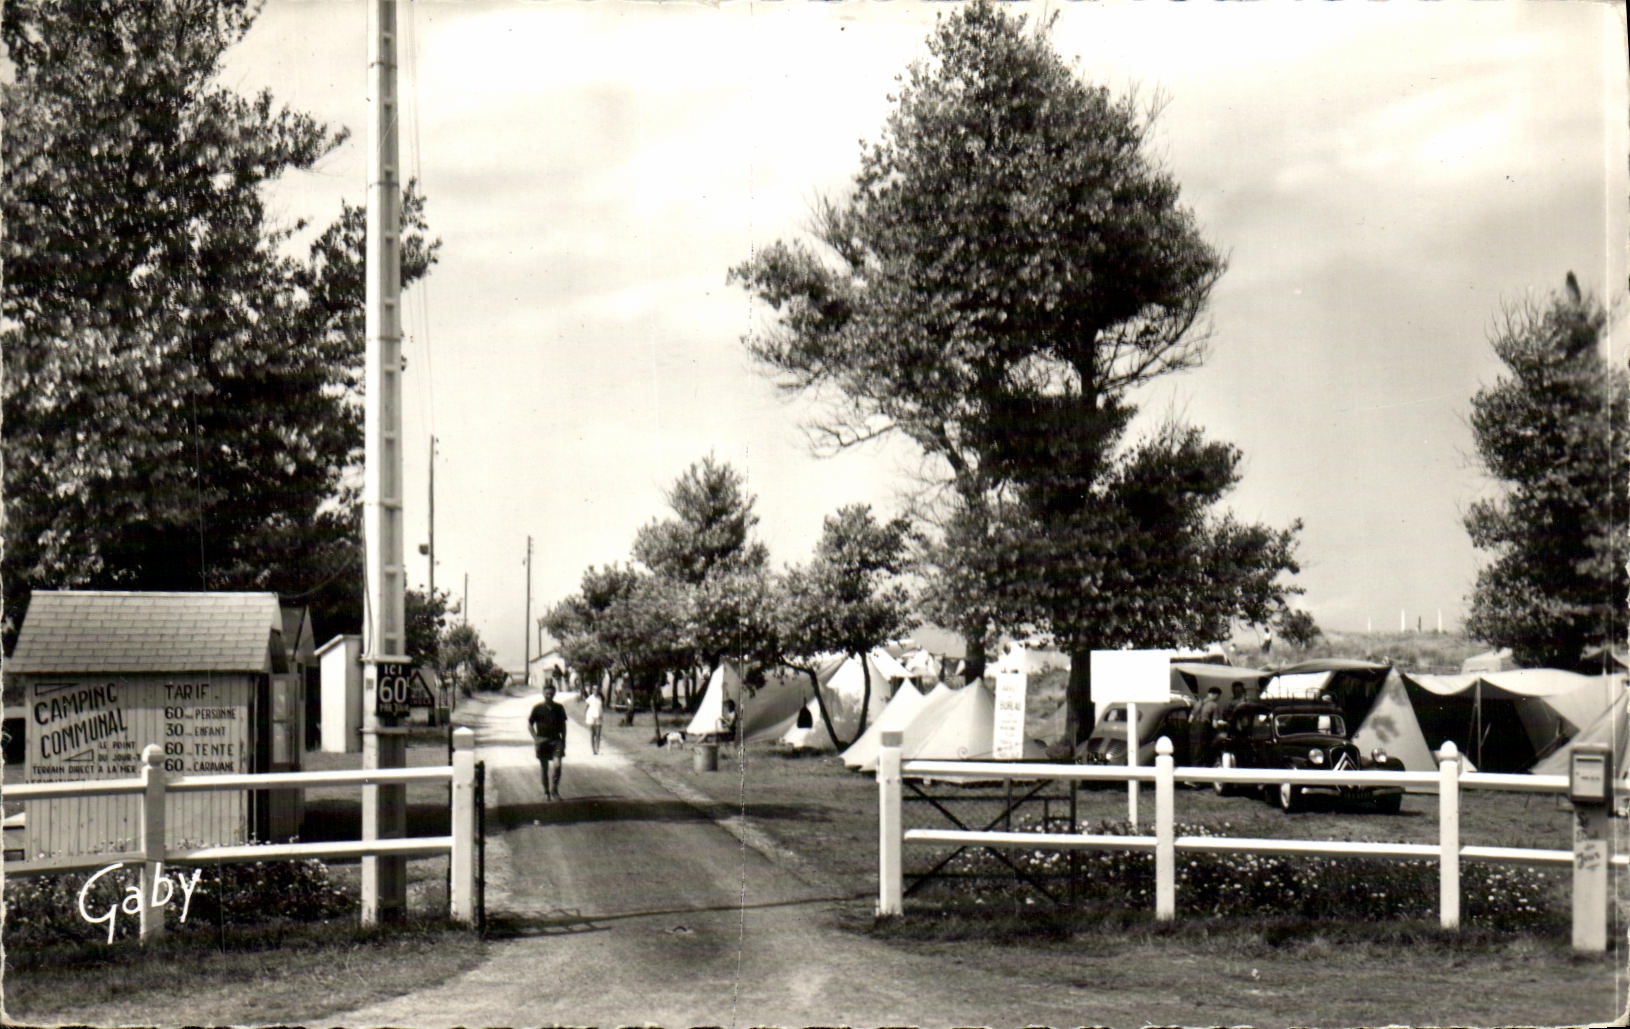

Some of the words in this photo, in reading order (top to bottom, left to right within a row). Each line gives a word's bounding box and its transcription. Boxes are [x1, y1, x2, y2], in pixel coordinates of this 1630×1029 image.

[384, 664, 402, 675] ICI
[164, 683, 210, 700] TARIF
[34, 683, 117, 726] CAMPING
[164, 706, 184, 720] 60
[41, 707, 129, 759] COMMUNAL
[165, 723, 184, 737] 30
[194, 726, 226, 737] ENFANT
[164, 742, 184, 756] 60
[194, 743, 234, 756] TENTE
[68, 765, 94, 774] DIRECT
[107, 765, 118, 774] LA
[164, 758, 184, 772] 60
